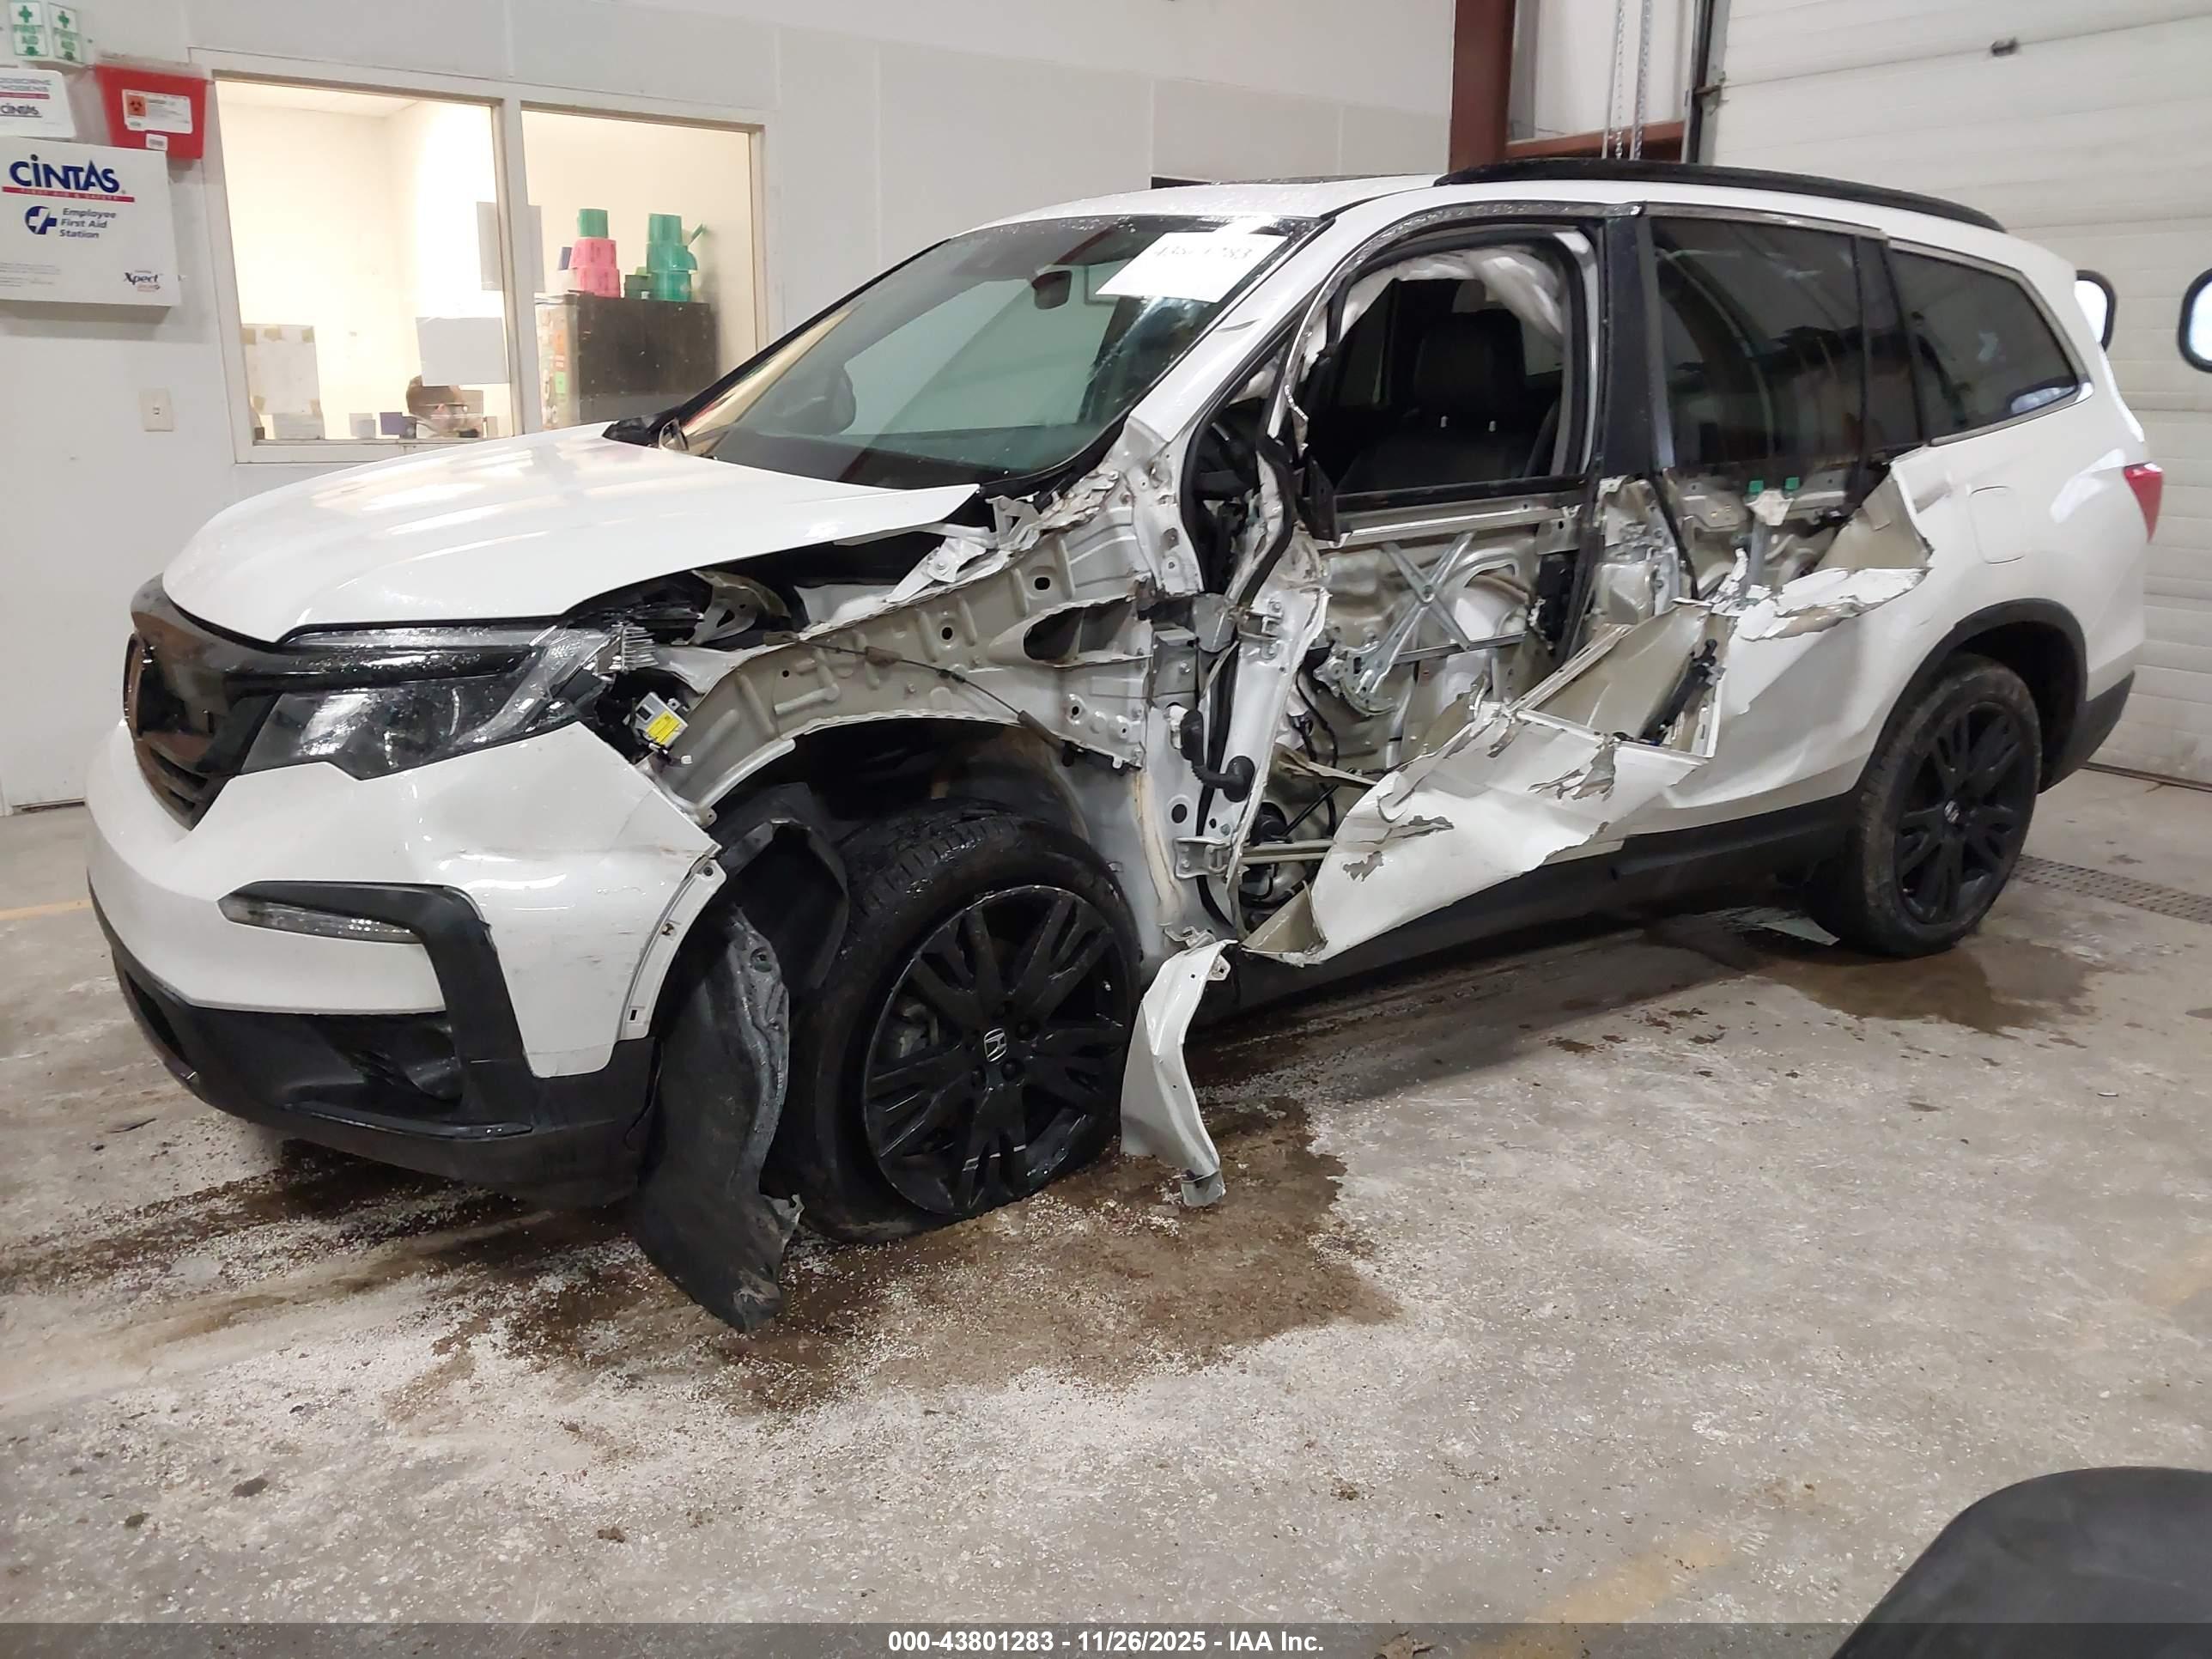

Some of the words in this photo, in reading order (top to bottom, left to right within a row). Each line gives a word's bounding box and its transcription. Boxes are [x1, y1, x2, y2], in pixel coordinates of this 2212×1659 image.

[63, 208, 117, 219] Employee
[61, 218, 85, 228] First
[88, 220, 107, 228] Aid
[59, 228, 100, 239] Station
